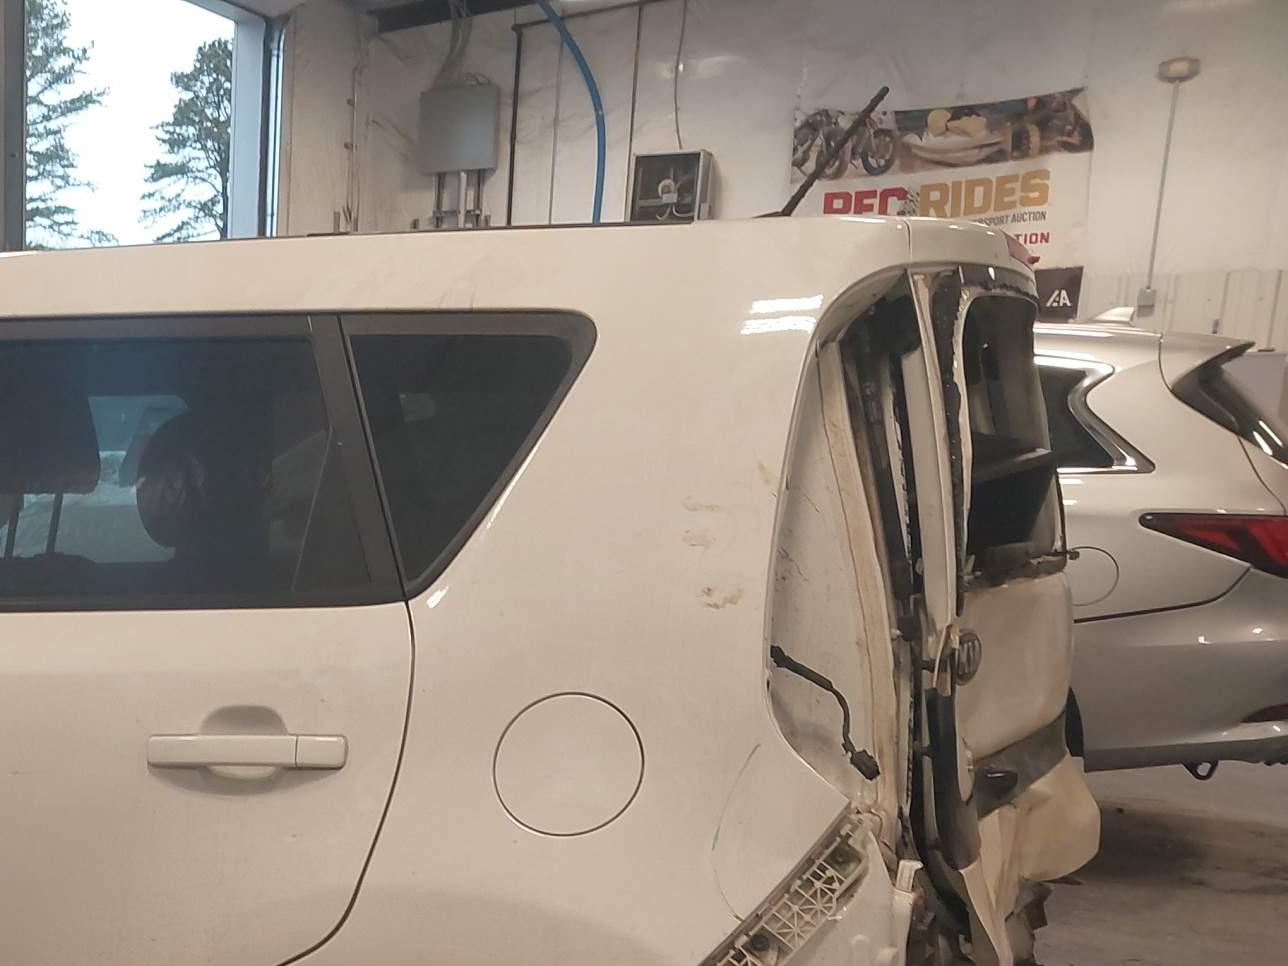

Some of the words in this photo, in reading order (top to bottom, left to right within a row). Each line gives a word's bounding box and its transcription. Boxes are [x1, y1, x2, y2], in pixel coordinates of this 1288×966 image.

[920, 169, 1050, 218] RIDES
[1011, 211, 1047, 223] AUCTION
[1014, 232, 1050, 245] TION
